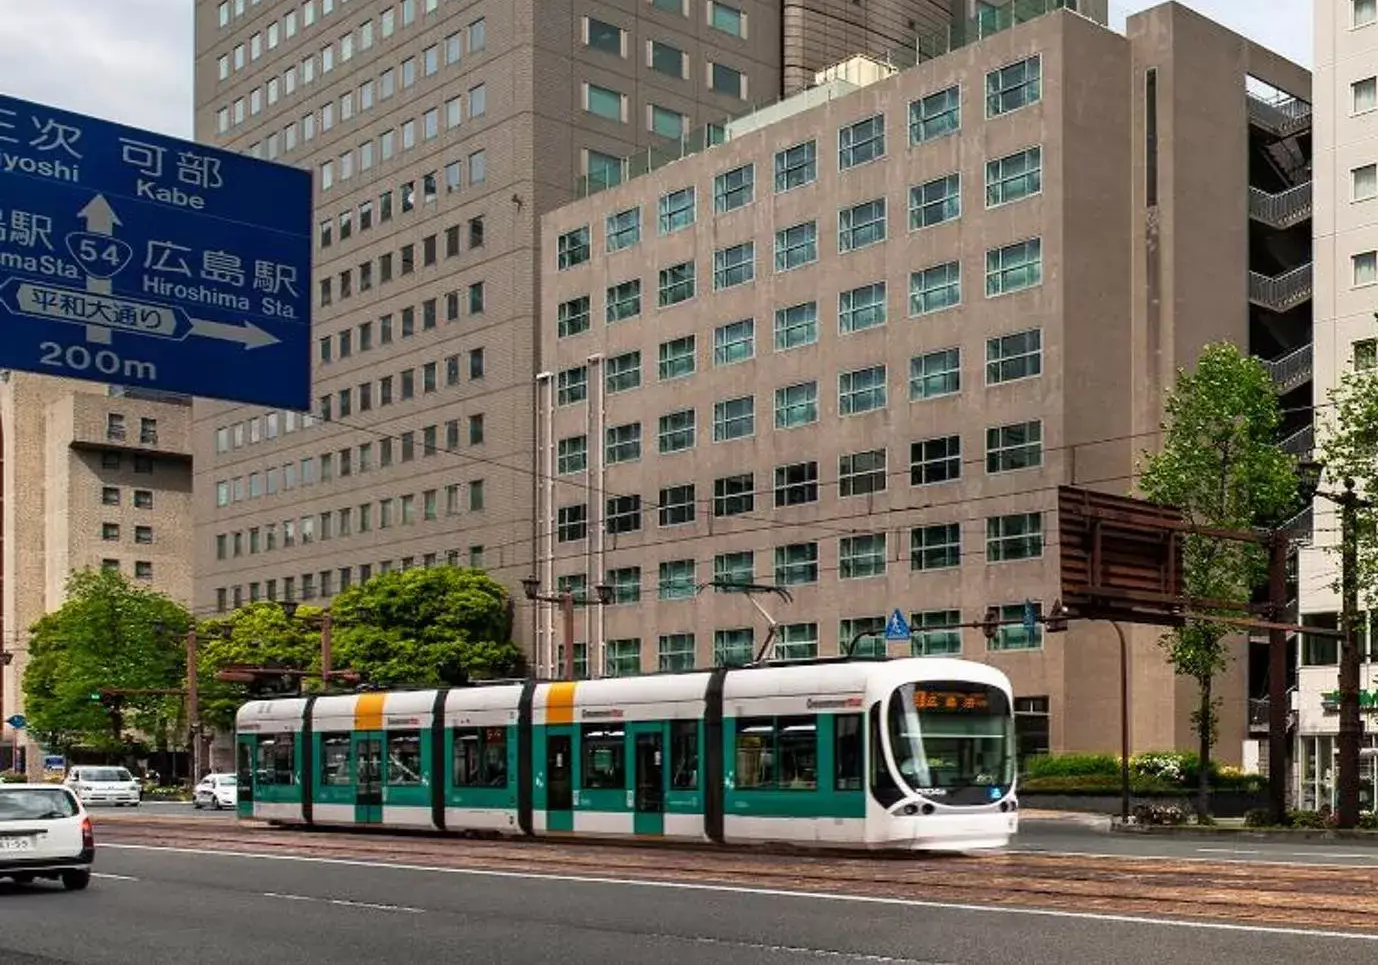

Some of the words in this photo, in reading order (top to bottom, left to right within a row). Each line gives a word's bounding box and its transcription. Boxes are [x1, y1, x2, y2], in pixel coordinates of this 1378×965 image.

[0, 152, 79, 183] yoshi
[118, 137, 224, 189] 可部
[136, 178, 206, 210] Kabe
[79, 239, 120, 267] 54
[143, 239, 299, 298] 広島駅
[31, 287, 162, 330] 平和大通り
[143, 275, 250, 311] Hiroshima
[39, 340, 157, 381] 200m
